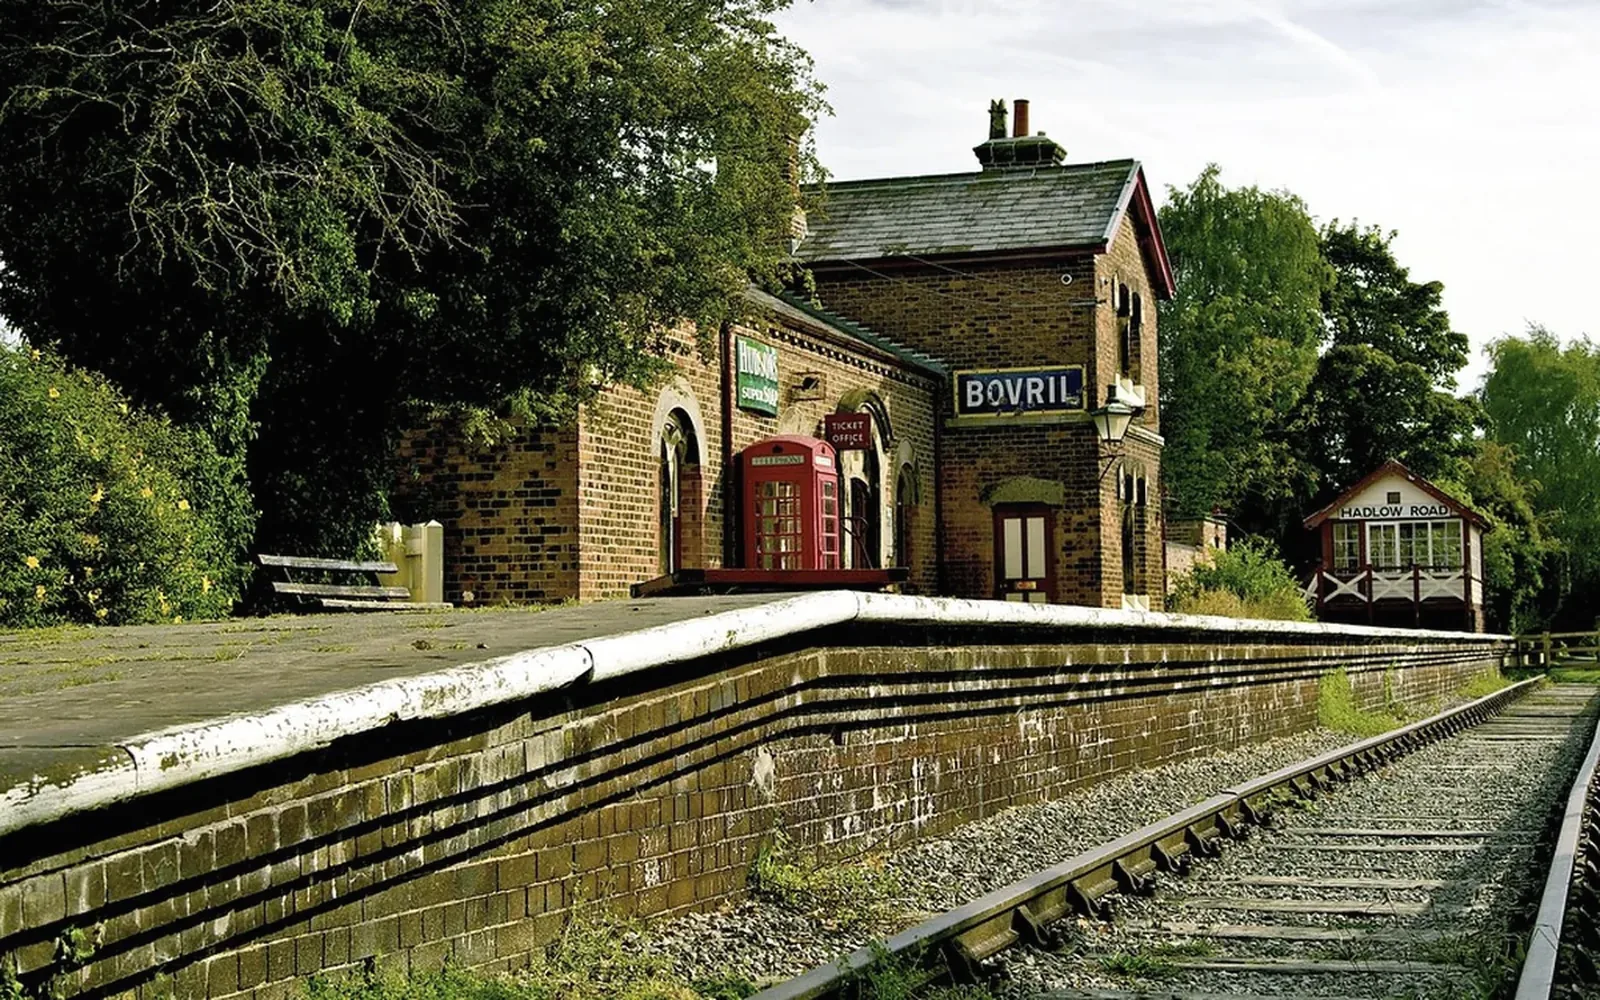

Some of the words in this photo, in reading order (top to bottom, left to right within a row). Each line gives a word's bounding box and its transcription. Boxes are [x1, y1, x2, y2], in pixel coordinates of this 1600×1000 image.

[966, 375, 1080, 407] BOVRIL
[832, 421, 864, 430] TICKET
[832, 434, 863, 443] OFFICE
[1341, 507, 1403, 518] HADLOW
[1410, 505, 1448, 516] ROAD
